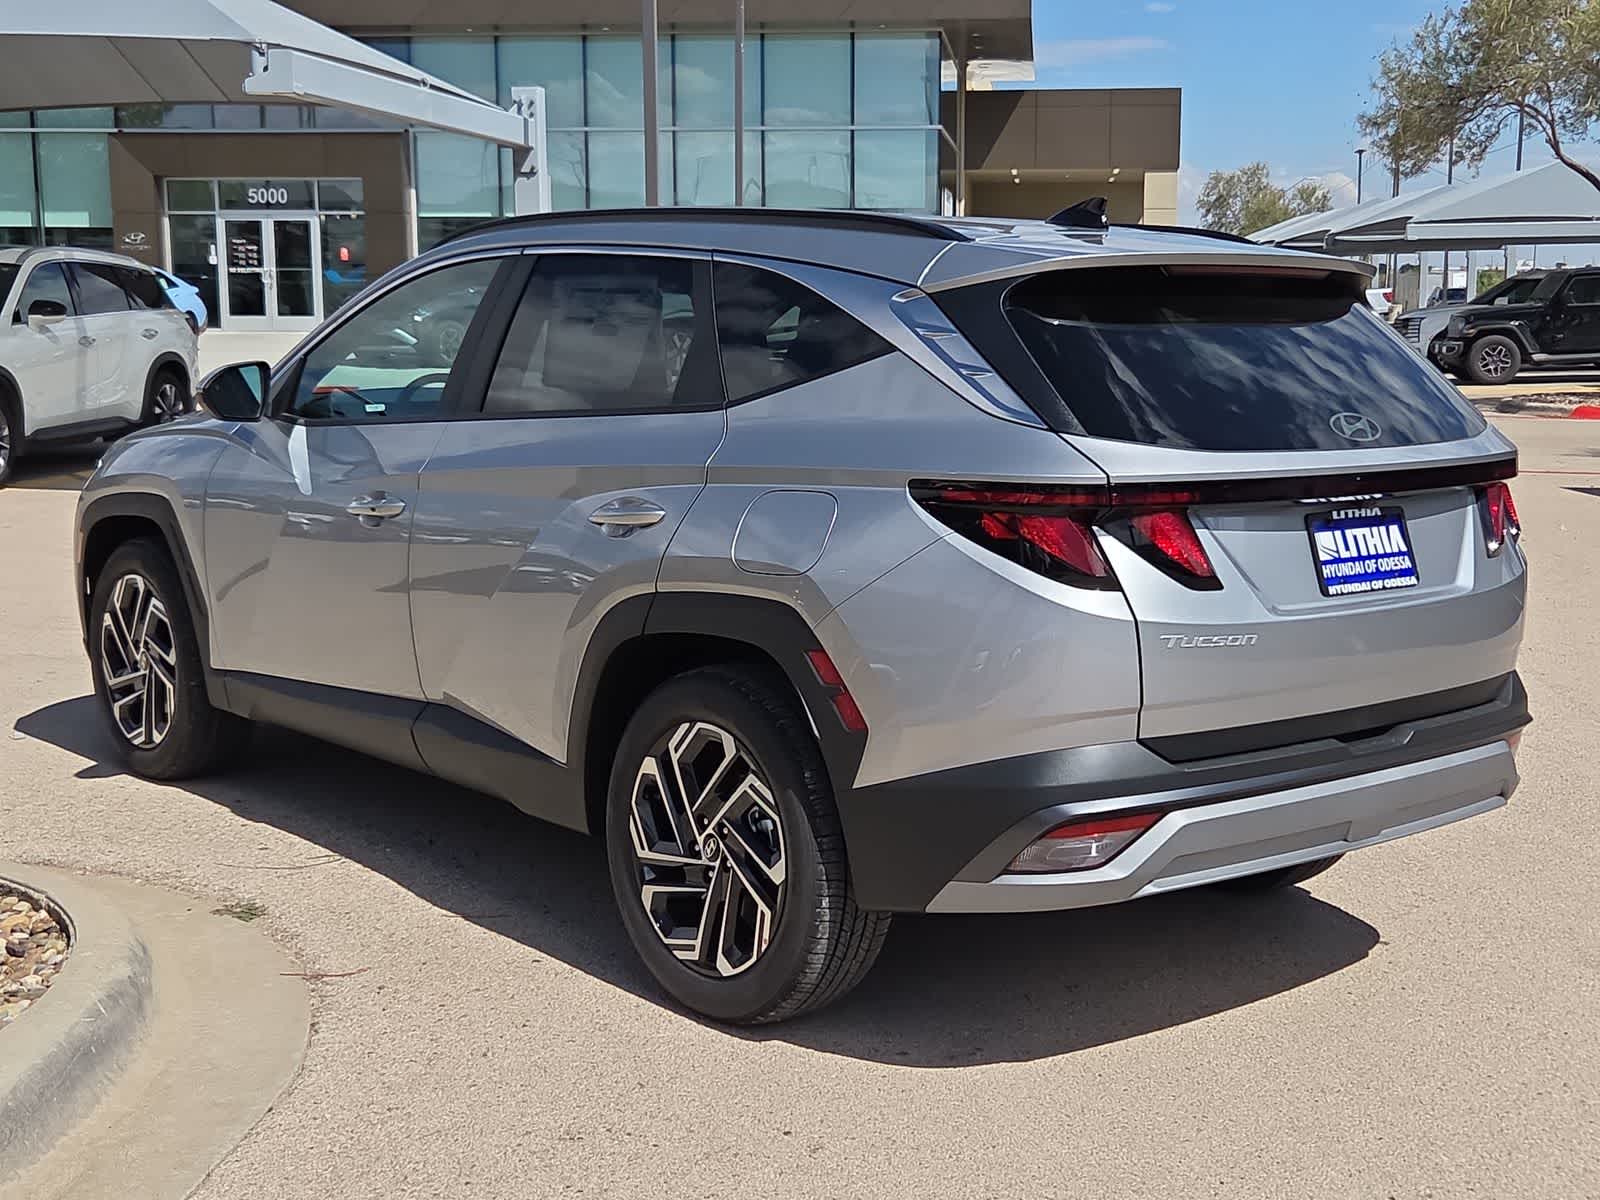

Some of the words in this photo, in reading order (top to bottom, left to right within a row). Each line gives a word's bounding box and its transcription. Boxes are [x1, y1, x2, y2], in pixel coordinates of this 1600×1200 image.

[248, 188, 288, 204] 5000
[1332, 507, 1382, 520] LITHIA
[1334, 525, 1408, 559] LITHIA
[1322, 561, 1365, 579] HYUNDAI
[1365, 559, 1378, 574] OF
[1378, 555, 1412, 572] ODESSA
[1328, 580, 1371, 595] HYUNDAI
[1371, 579, 1384, 590] OF
[1384, 575, 1418, 588] ODESSA
